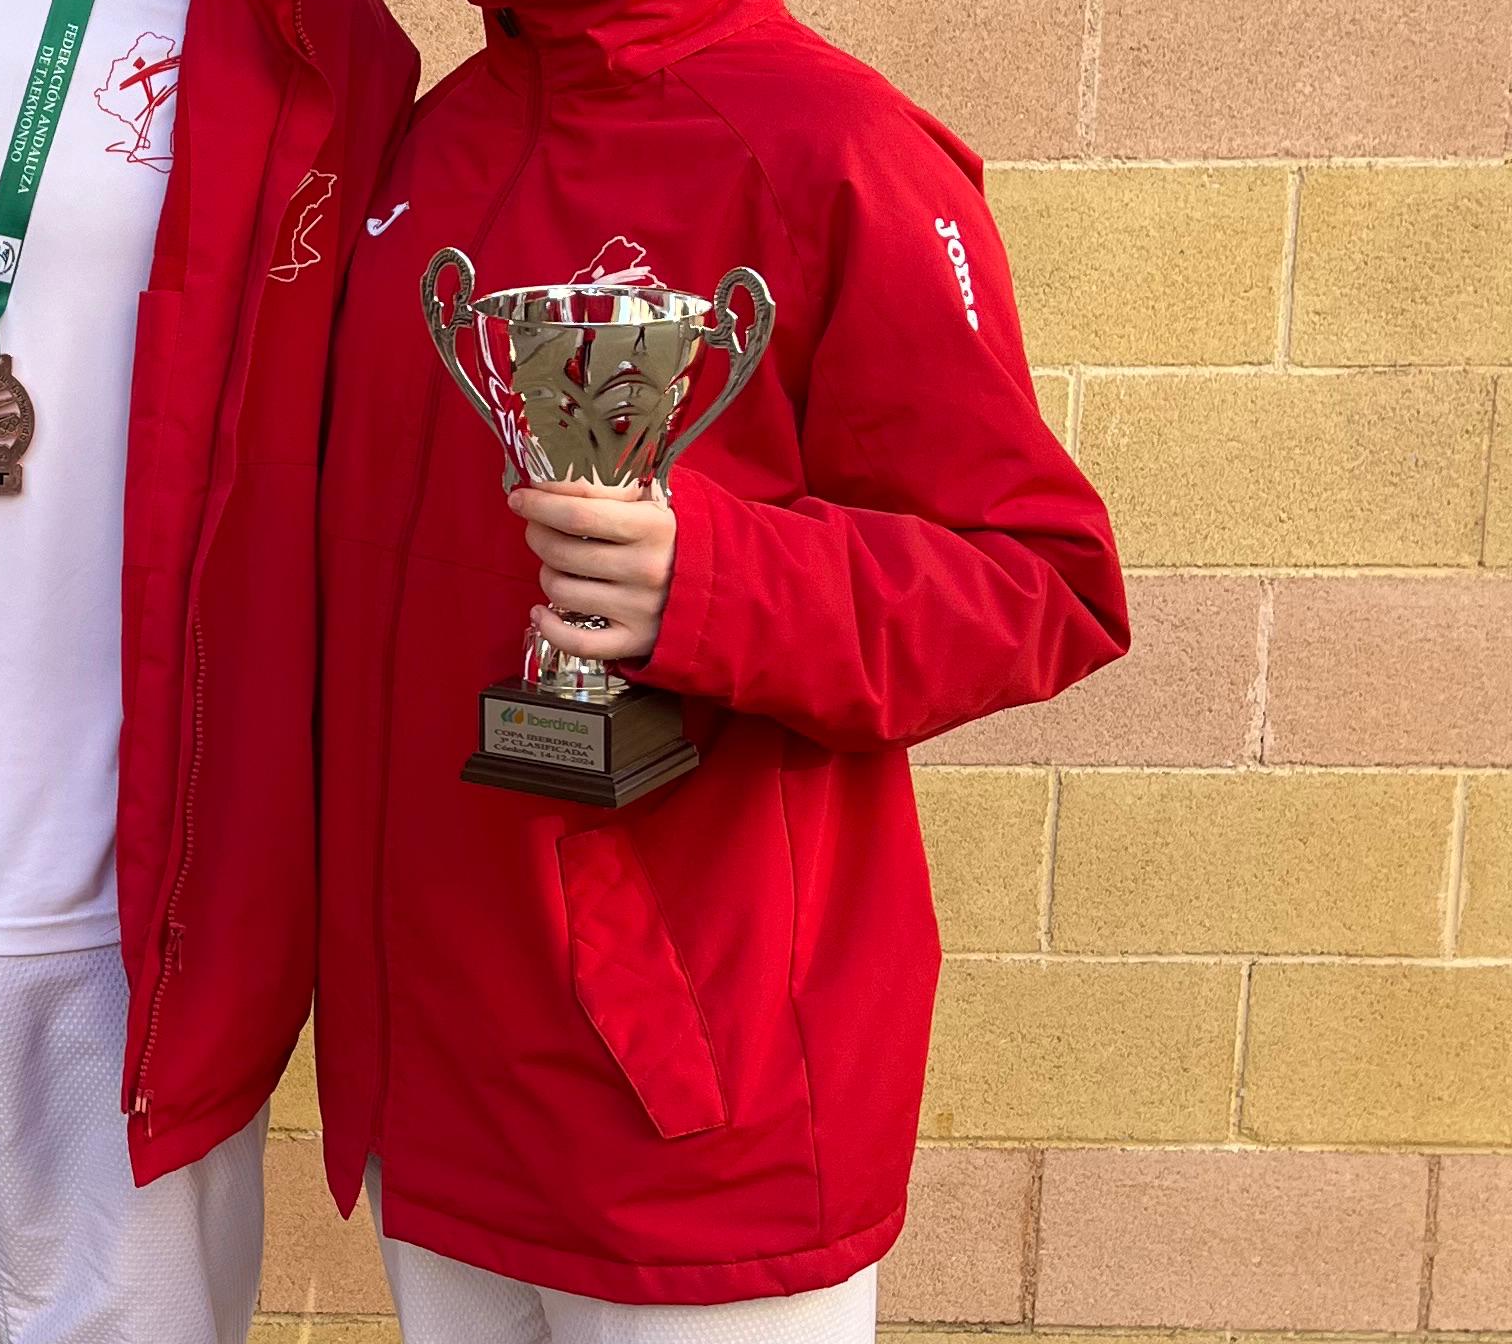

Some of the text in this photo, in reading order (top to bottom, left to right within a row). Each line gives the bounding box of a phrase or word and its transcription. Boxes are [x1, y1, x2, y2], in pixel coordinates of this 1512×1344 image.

[10, 45, 54, 164] DE TAEKWONDO
[17, 22, 79, 194] FEDERACIÓN ANDALUZA
[527, 712, 589, 735] Iberdrola
[494, 729, 594, 751] COPA IBERDROLA
[511, 739, 589, 757] CLASIFICADA
